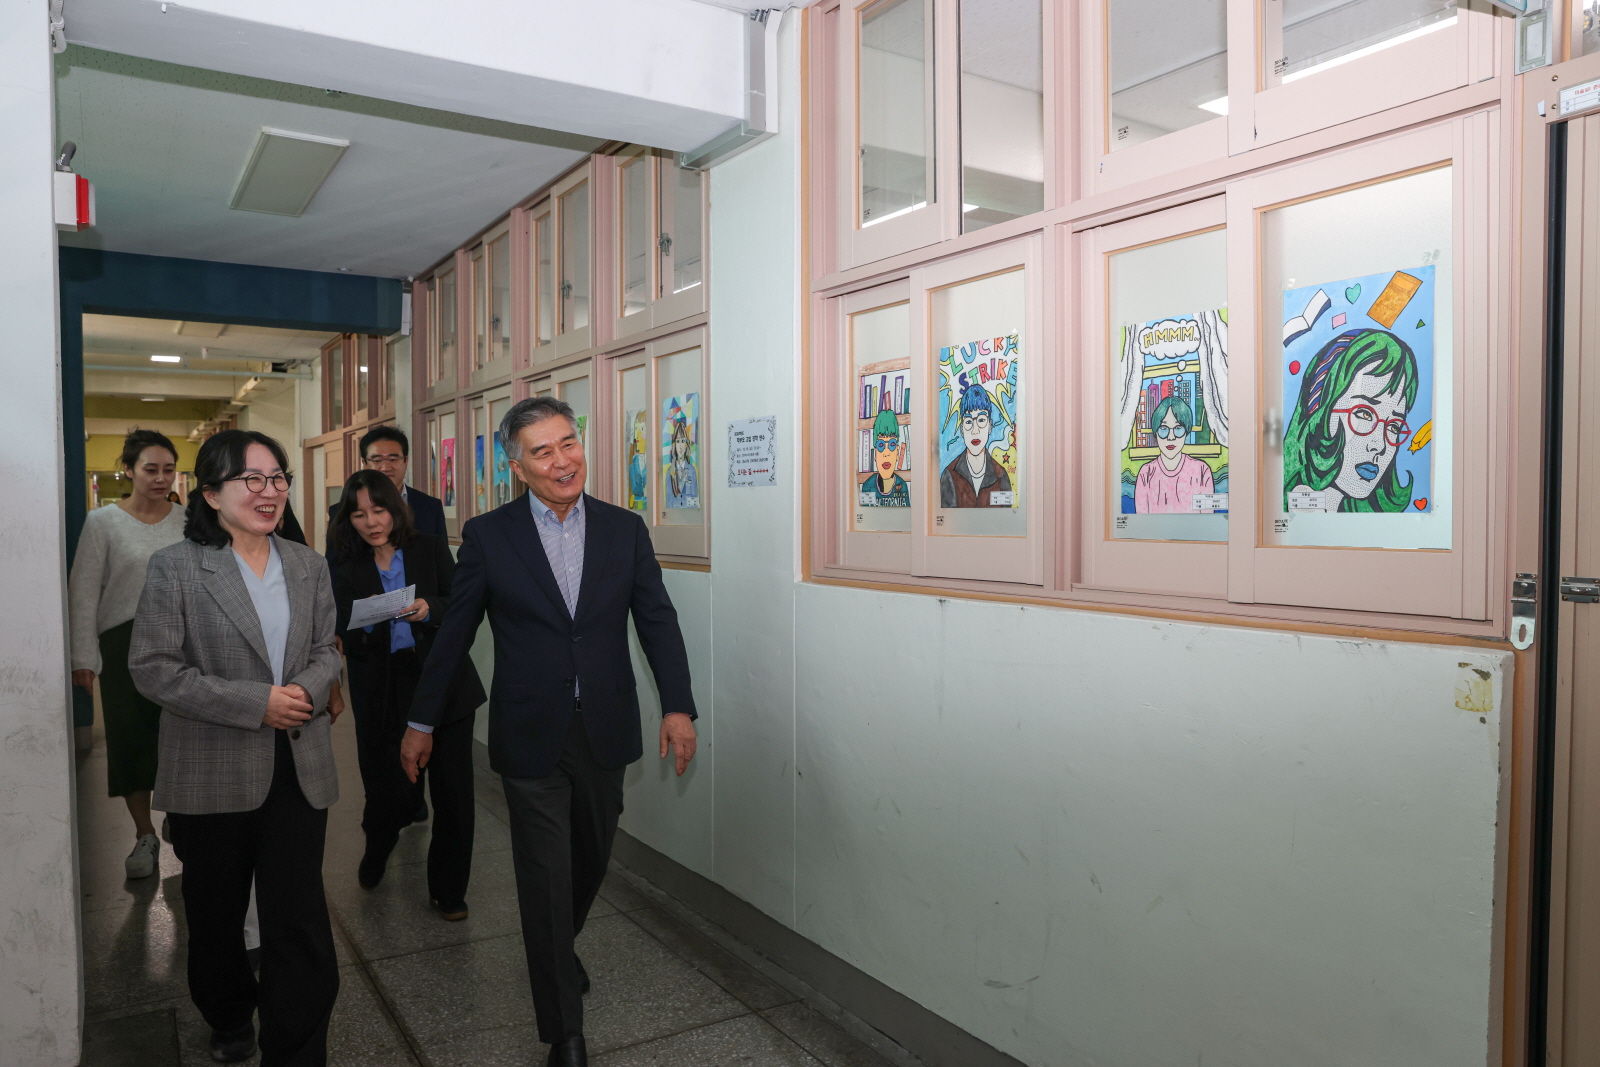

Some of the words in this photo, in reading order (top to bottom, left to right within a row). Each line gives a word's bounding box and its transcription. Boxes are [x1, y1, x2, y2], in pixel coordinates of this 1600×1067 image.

[949, 336, 1017, 376] LUCKY
[958, 358, 1018, 395] STRIKE
[868, 497, 907, 507] ALIFORNIA
